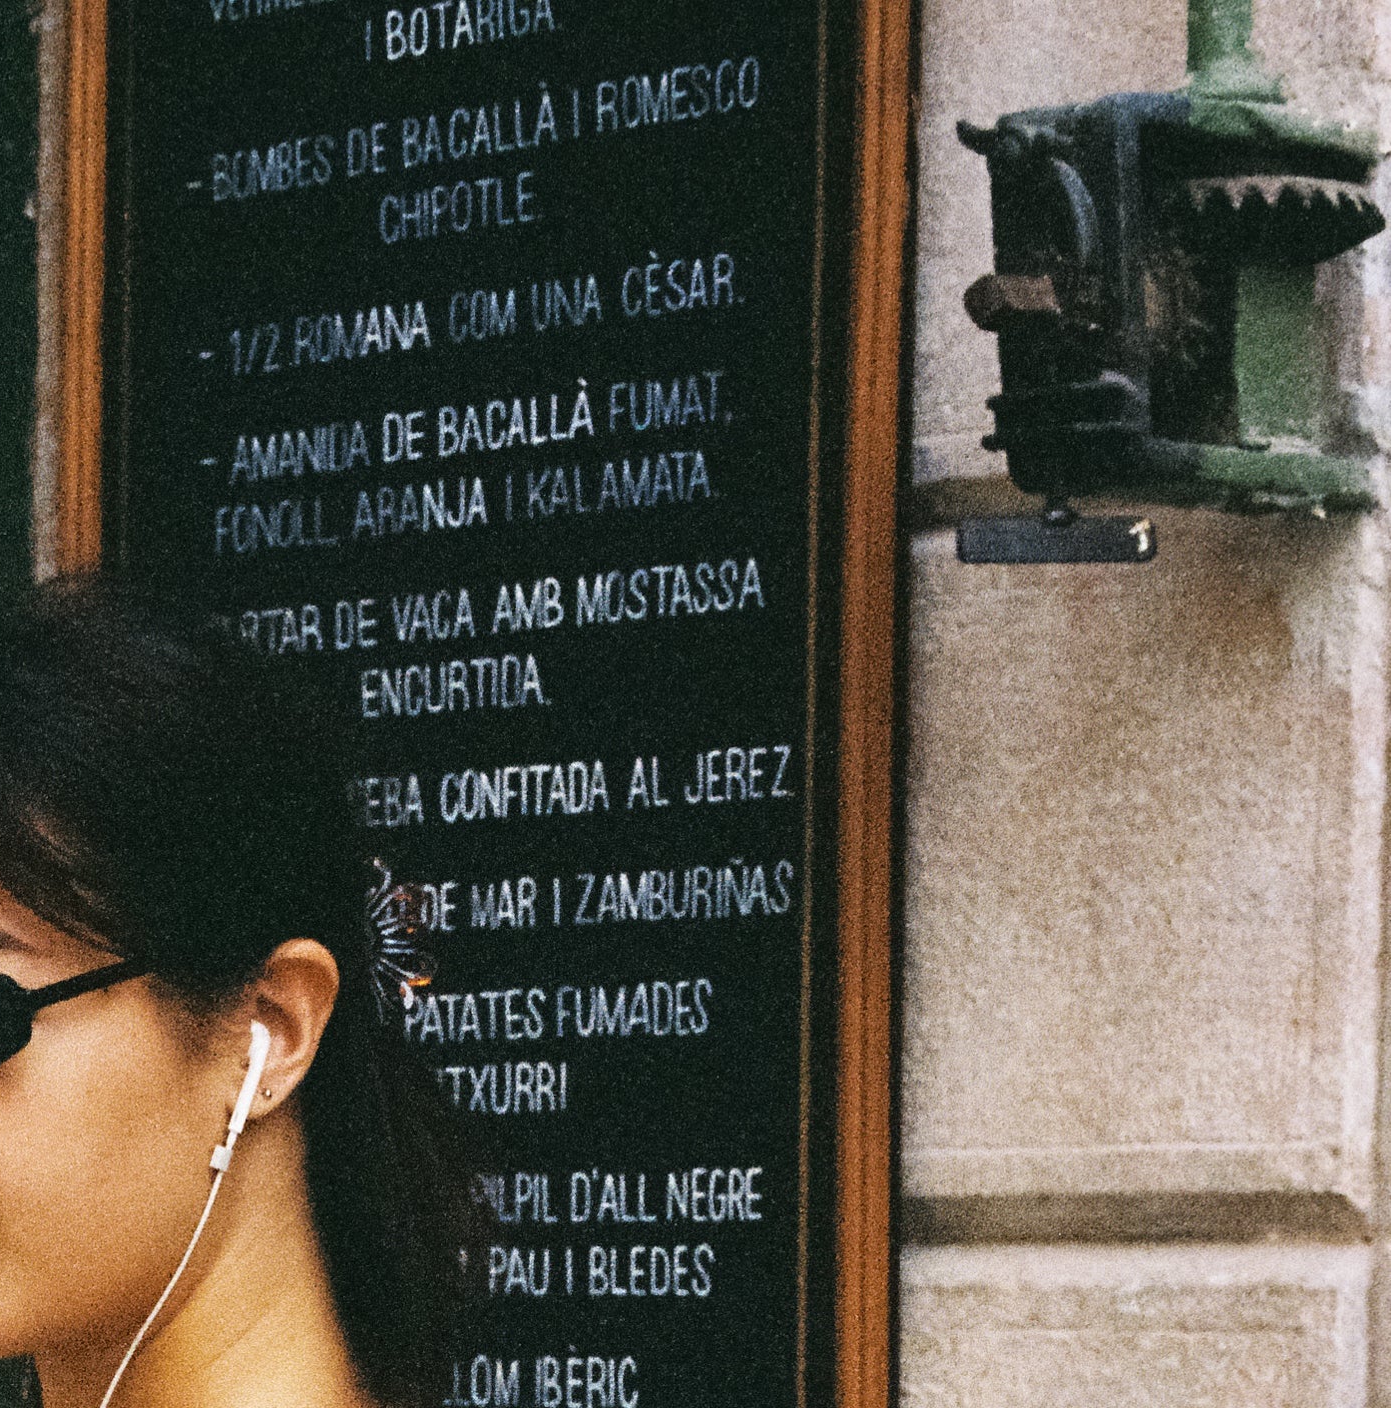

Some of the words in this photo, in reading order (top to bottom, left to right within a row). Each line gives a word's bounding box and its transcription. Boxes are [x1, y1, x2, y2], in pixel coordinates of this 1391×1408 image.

[211, 134, 336, 202] BOMBES
[347, 121, 388, 177] DE
[403, 81, 558, 168] BACALLÀ
[572, 88, 581, 138] I
[596, 55, 760, 133] ROMESCO
[294, 300, 431, 365] ROMANA
[449, 287, 517, 344] COM
[532, 273, 603, 332] UNA
[228, 420, 371, 485] AMANIDA
[382, 410, 426, 463] DE
[437, 376, 595, 457] BACALLÀ
[351, 475, 488, 537] ARANJA
[505, 474, 513, 522] I
[334, 599, 379, 651] DE
[392, 588, 476, 643] VACA
[491, 576, 565, 634] AMB
[575, 557, 765, 629] MOSTASSA
[359, 773, 425, 827] EBA
[440, 758, 610, 824] CONFITADA
[627, 755, 669, 810] AL
[470, 874, 537, 930] MAR
[553, 877, 562, 926] I
[574, 856, 795, 926] ZAMBURIÑAS
[404, 986, 547, 1044] PATATES
[556, 978, 712, 1038] FUMADES
[569, 1166, 657, 1224] D'ALL
[666, 1166, 764, 1224] NEGRE
[489, 1244, 551, 1296] PAU
[565, 1248, 573, 1295] I
[588, 1243, 716, 1297] BLEDES
